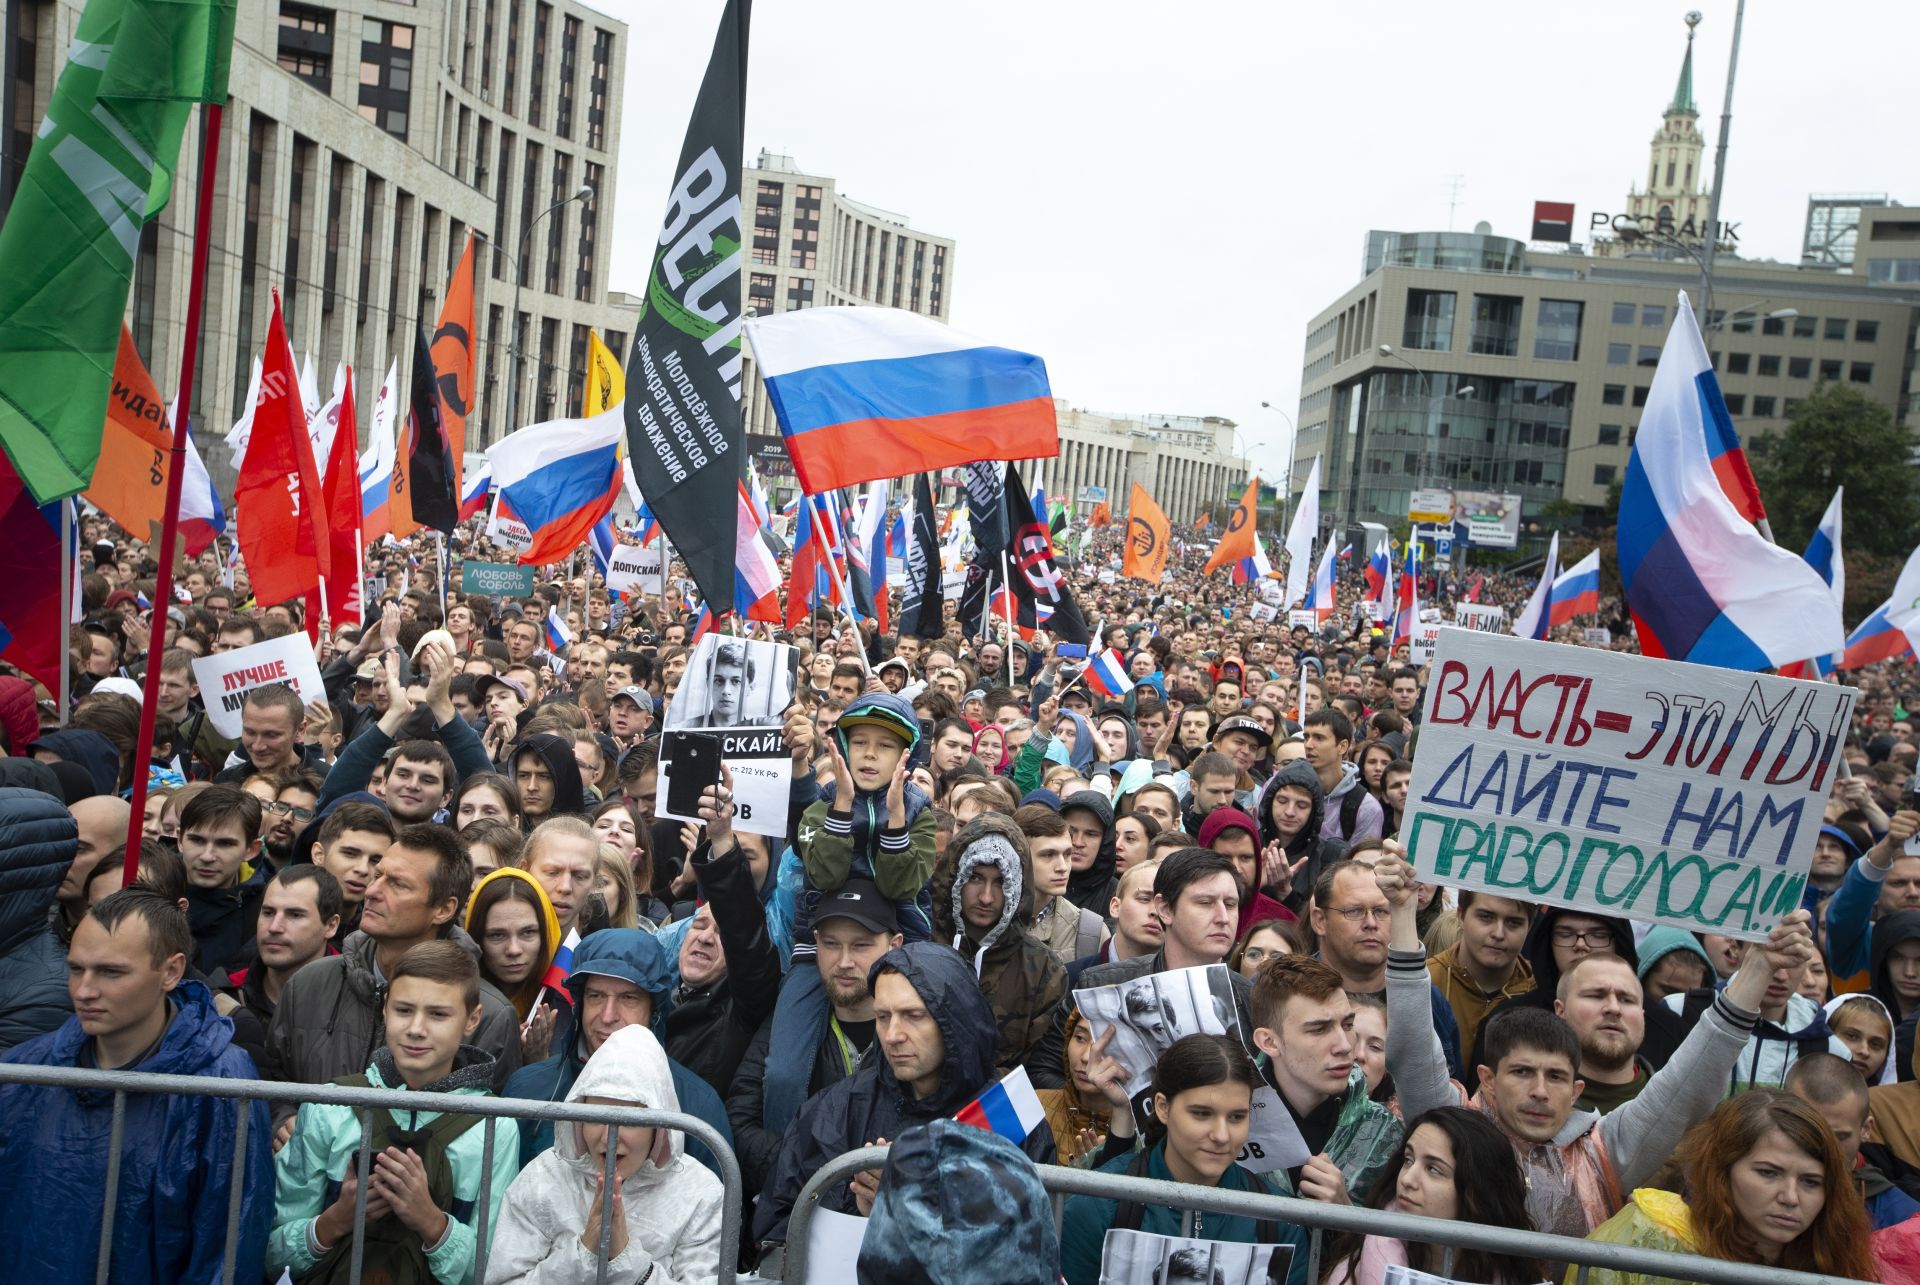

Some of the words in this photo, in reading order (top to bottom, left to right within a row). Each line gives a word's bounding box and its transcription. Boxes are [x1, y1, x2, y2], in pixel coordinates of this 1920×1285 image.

[637, 334, 708, 470] демократическое
[662, 349, 729, 456] Молодёжное
[638, 402, 687, 484] движение
[763, 445, 782, 454] 2019
[498, 529, 532, 544] ВЫБИРАЕМ
[508, 524, 527, 535] ЗДЕСЬ
[471, 569, 523, 580] ЛЮБОВЬ
[478, 580, 526, 590] СОБОЛЬ
[222, 660, 288, 692] ЛУЧШЕ
[722, 733, 783, 753] СКАЙ!
[1625, 691, 1726, 769] ЭТО
[1706, 680, 1850, 792] МЫ
[741, 766, 752, 775] 212
[754, 769, 764, 777] УК
[766, 771, 778, 779] РФ
[1421, 743, 1638, 834] ДАЙТЕ
[1661, 782, 1806, 865] НАМ
[1407, 811, 1570, 896] ПРАВО
